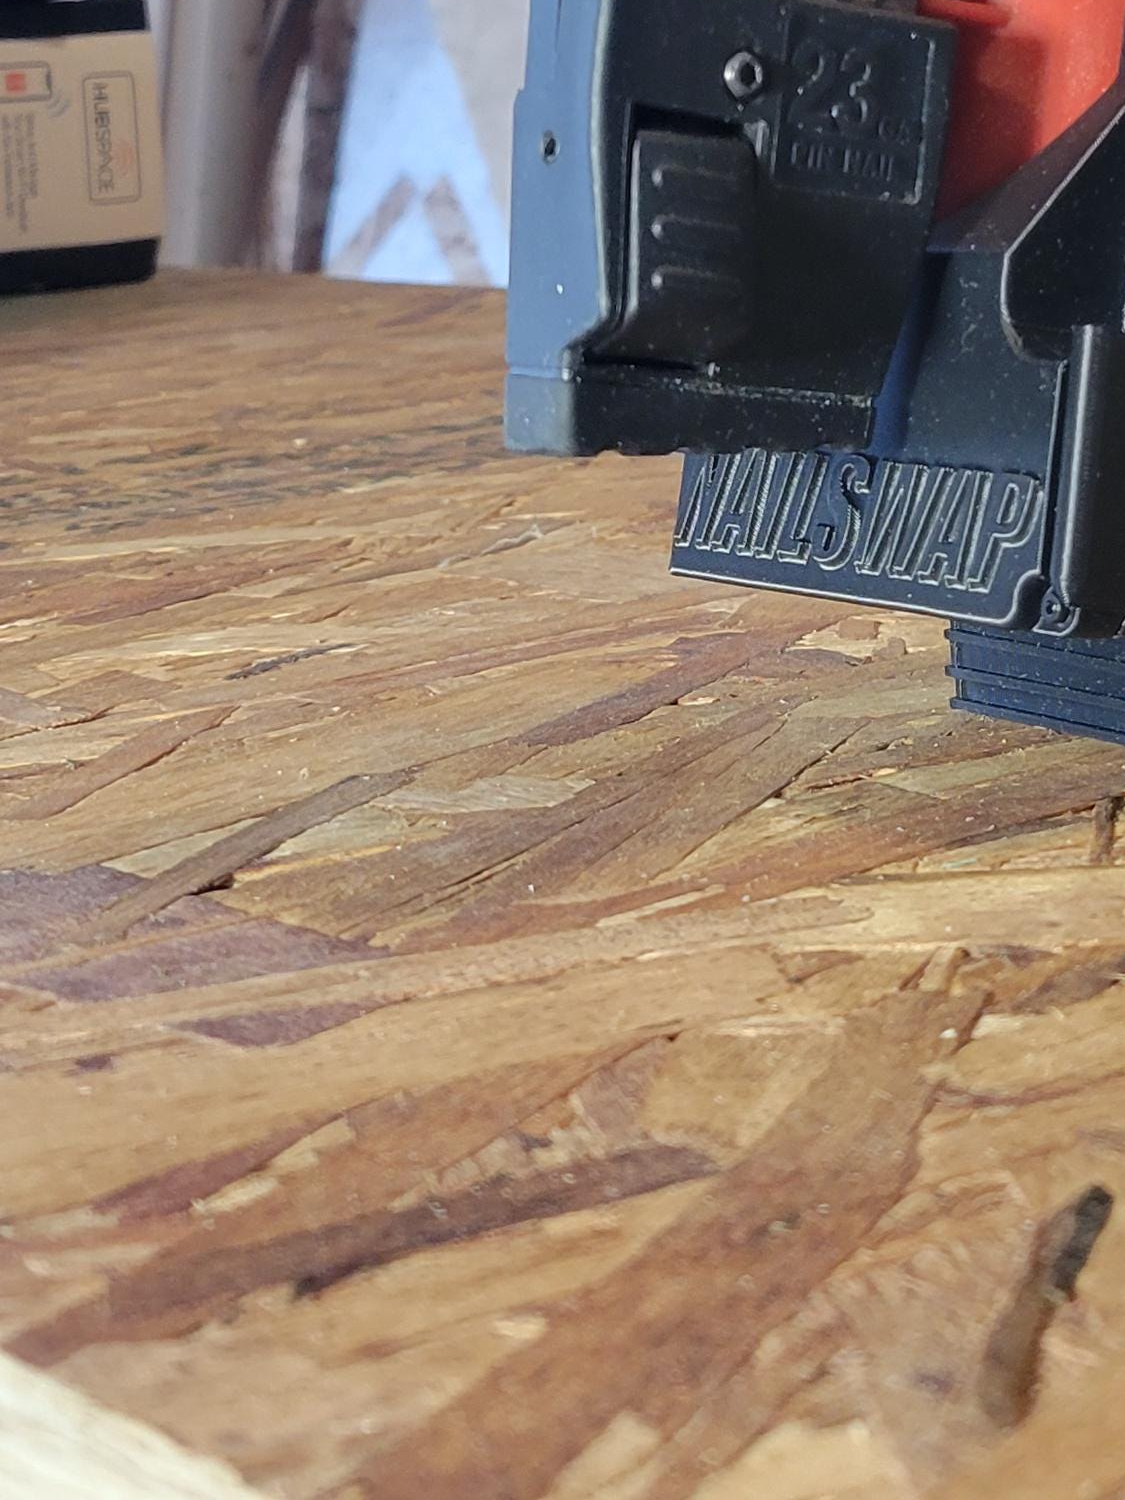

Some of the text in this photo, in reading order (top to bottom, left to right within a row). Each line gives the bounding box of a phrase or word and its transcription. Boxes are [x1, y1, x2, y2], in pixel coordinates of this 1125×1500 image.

[92, 82, 115, 193] HUBSPACE
[787, 41, 872, 134] 23
[674, 449, 1041, 593] NAILSWAP
